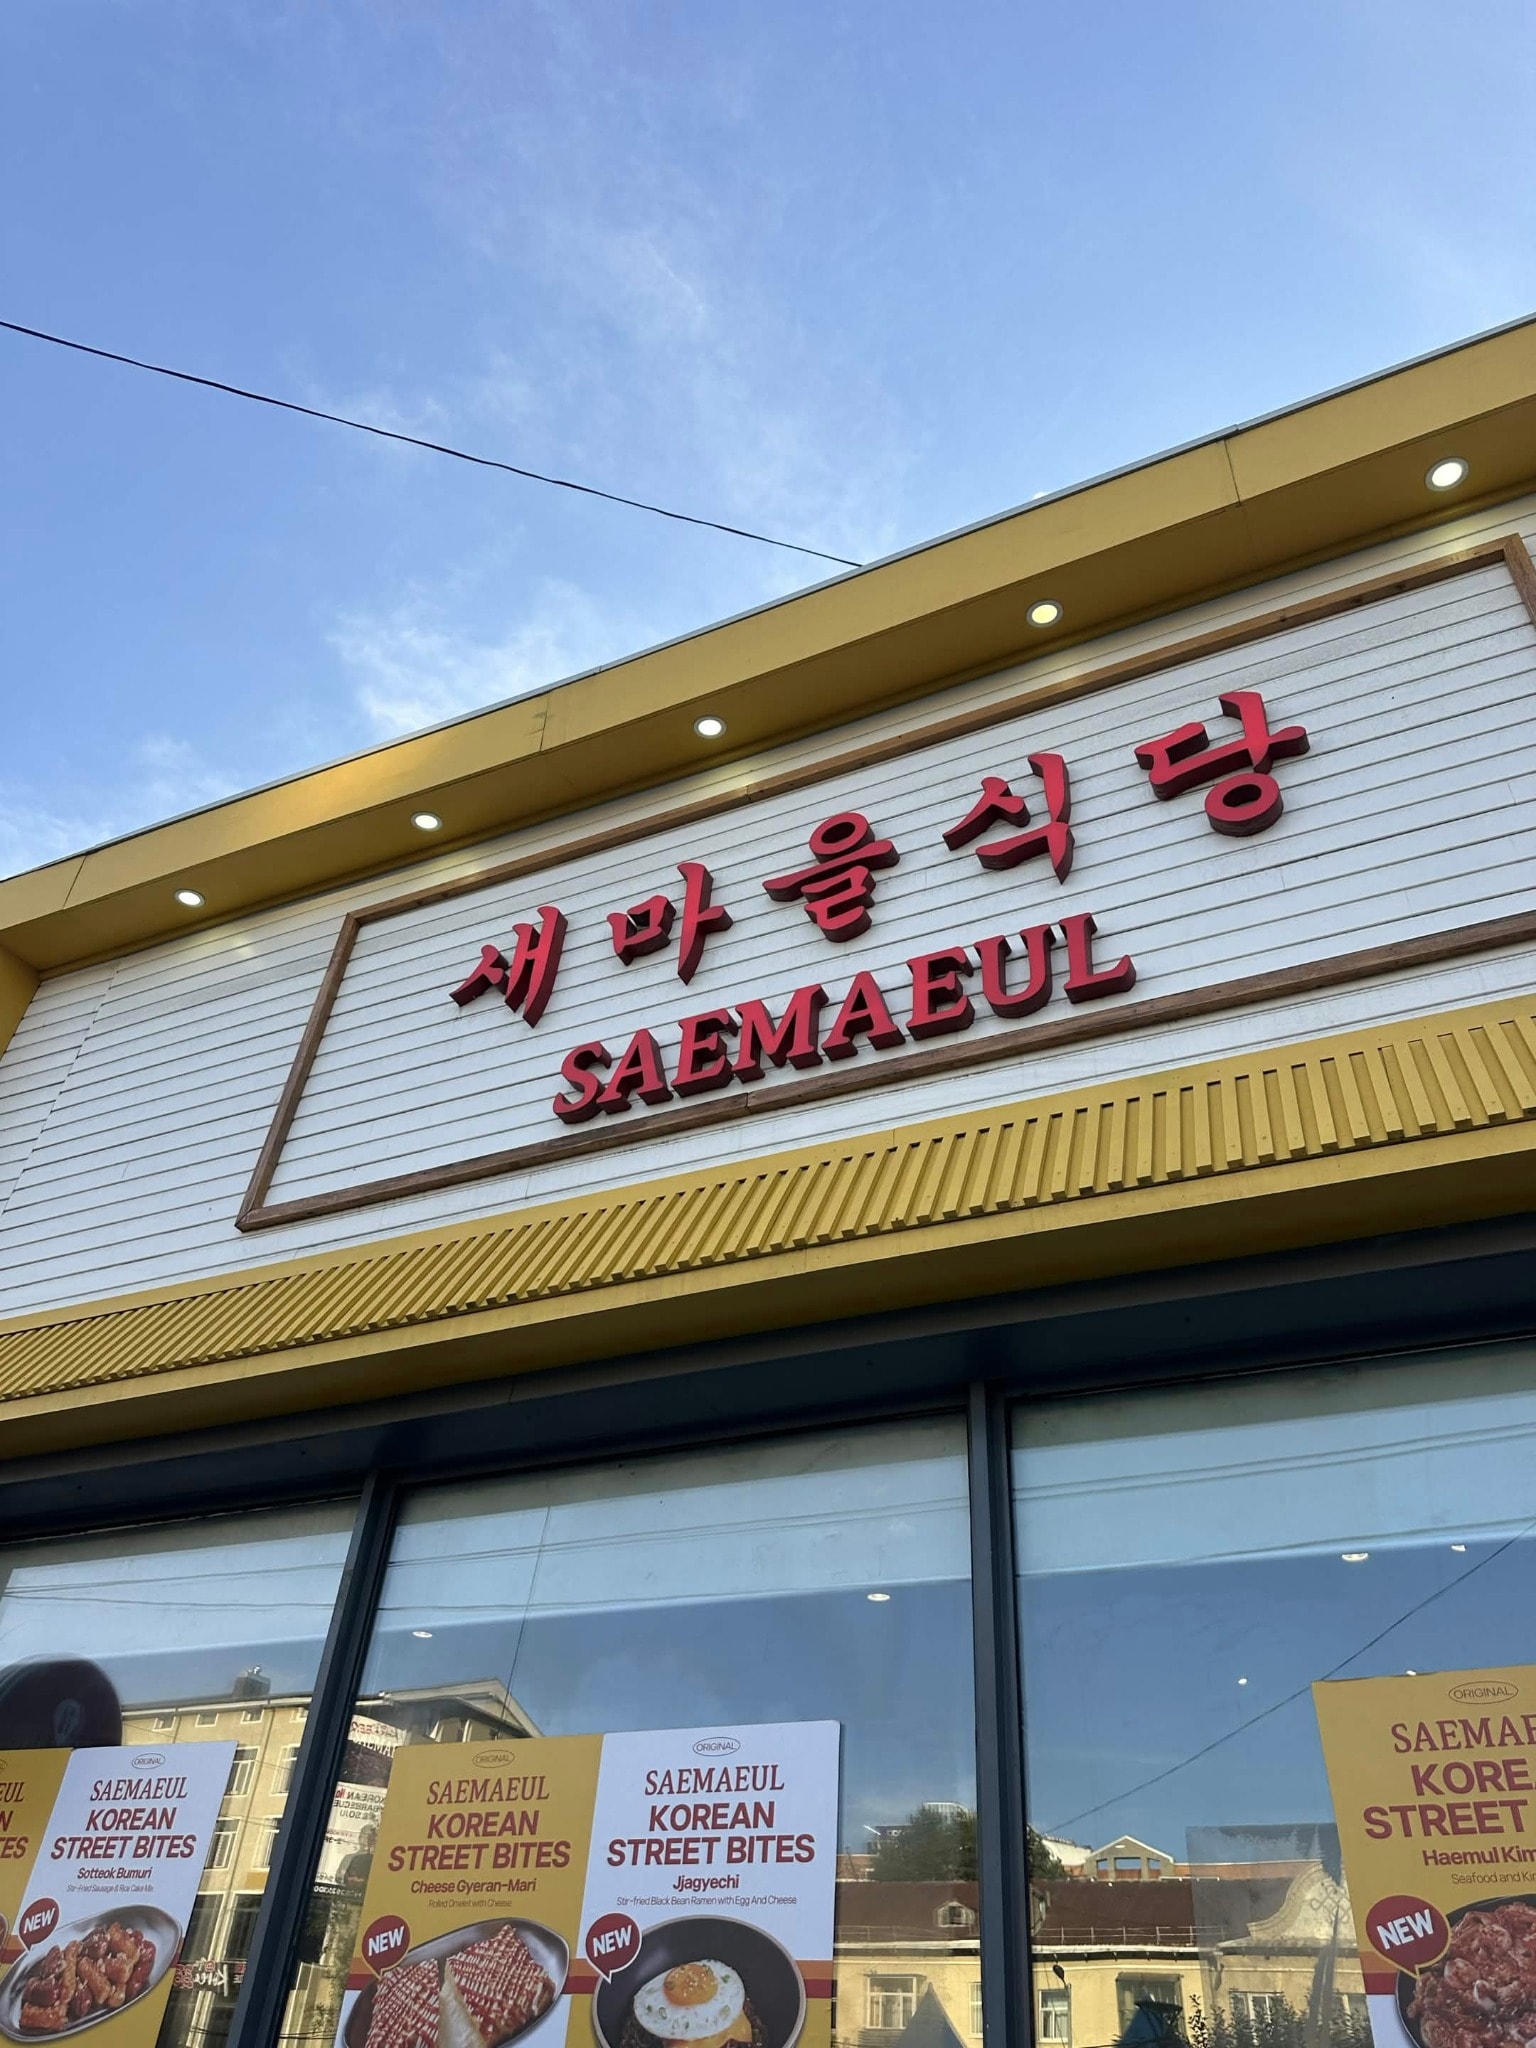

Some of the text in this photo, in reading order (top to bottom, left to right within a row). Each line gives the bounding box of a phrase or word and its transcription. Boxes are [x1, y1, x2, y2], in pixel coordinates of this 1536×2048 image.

[552, 911, 1138, 1126] SAEMAEUL
[1453, 1686, 1514, 1700] ORIGINAL
[476, 1754, 512, 1764] ORIGINAL
[696, 1741, 737, 1752] ORIGINAL
[134, 1756, 163, 1766] ORIGINAL
[90, 1777, 188, 1802] SAEMAEUL
[645, 1765, 785, 1796] SAEMAEUL
[1411, 1758, 1536, 1796] KORE
[426, 1776, 550, 1805] SAEMAEUL
[85, 1807, 177, 1832] KOREAN
[428, 1810, 540, 1839] KOREAN
[649, 1801, 775, 1832] KOREAN
[1363, 1799, 1528, 1840] STREET
[51, 1835, 133, 1860] STREET
[132, 1834, 197, 1859] BITES
[387, 1841, 571, 1872] STREET BITES
[607, 1834, 815, 1866] STREET BITES
[1422, 1846, 1499, 1866] Haemul
[77, 1866, 153, 1879] Sotteok Bumuri
[673, 1874, 740, 1892] Jjagyechi
[1451, 1872, 1498, 1885] Seafood
[1499, 1872, 1521, 1883] and
[411, 1878, 537, 1895] Cheese Gyeran-Mari
[617, 1895, 797, 1907] Stir-fried Black Bean Ramen with Egg And Cheese
[23, 1907, 55, 1934] NEW
[1376, 1908, 1434, 1950] NEW
[368, 1925, 405, 1956] NEW
[592, 1924, 632, 1957] NEW
